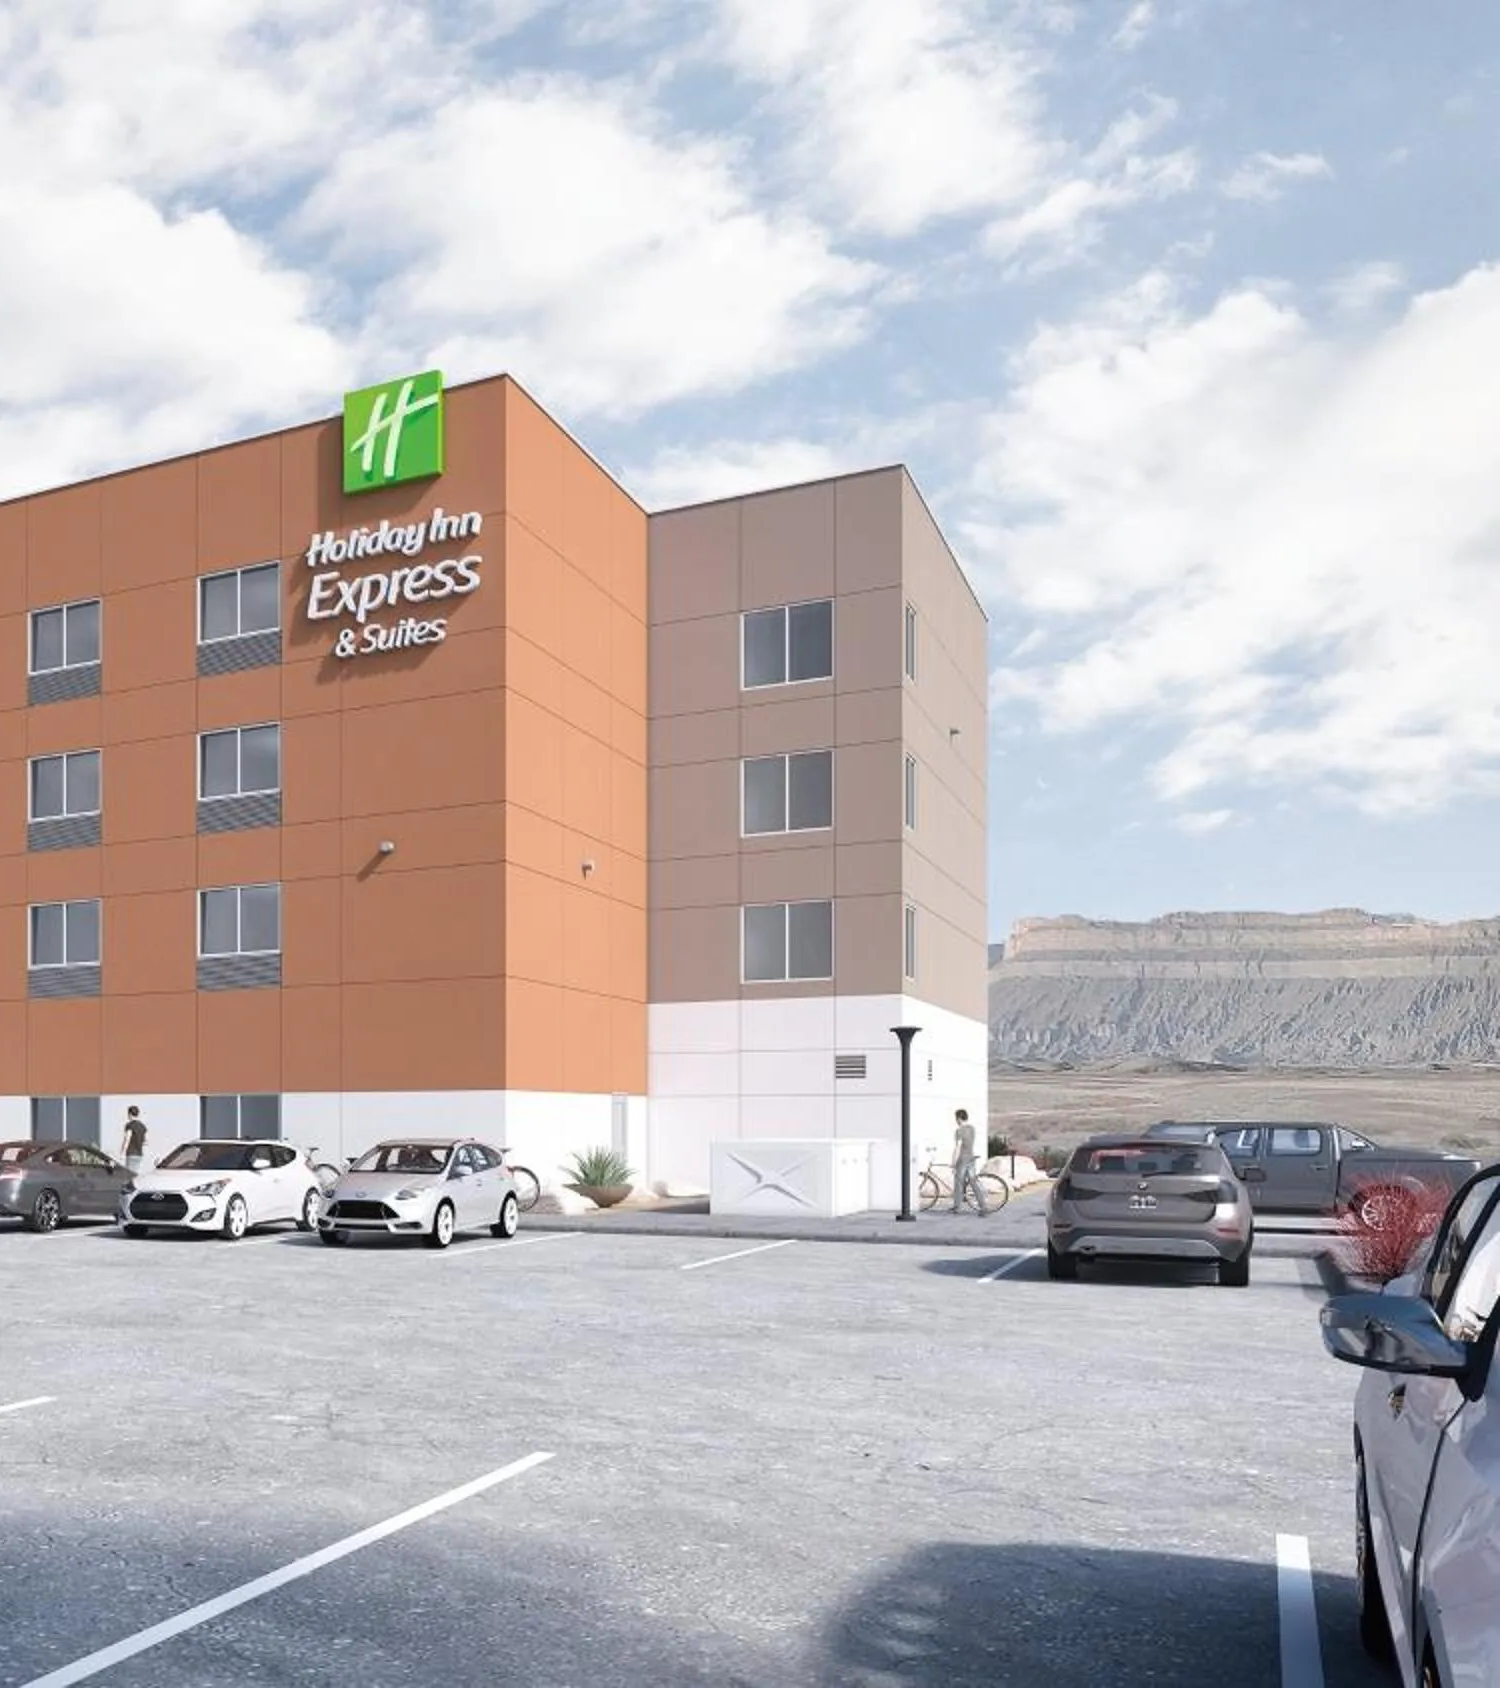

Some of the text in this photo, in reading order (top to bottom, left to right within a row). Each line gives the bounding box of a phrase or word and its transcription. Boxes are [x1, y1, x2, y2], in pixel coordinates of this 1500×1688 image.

[350, 380, 439, 477] H
[307, 508, 482, 567] Holiday Inn
[307, 555, 483, 622] Express
[335, 618, 447, 657] & Suites
